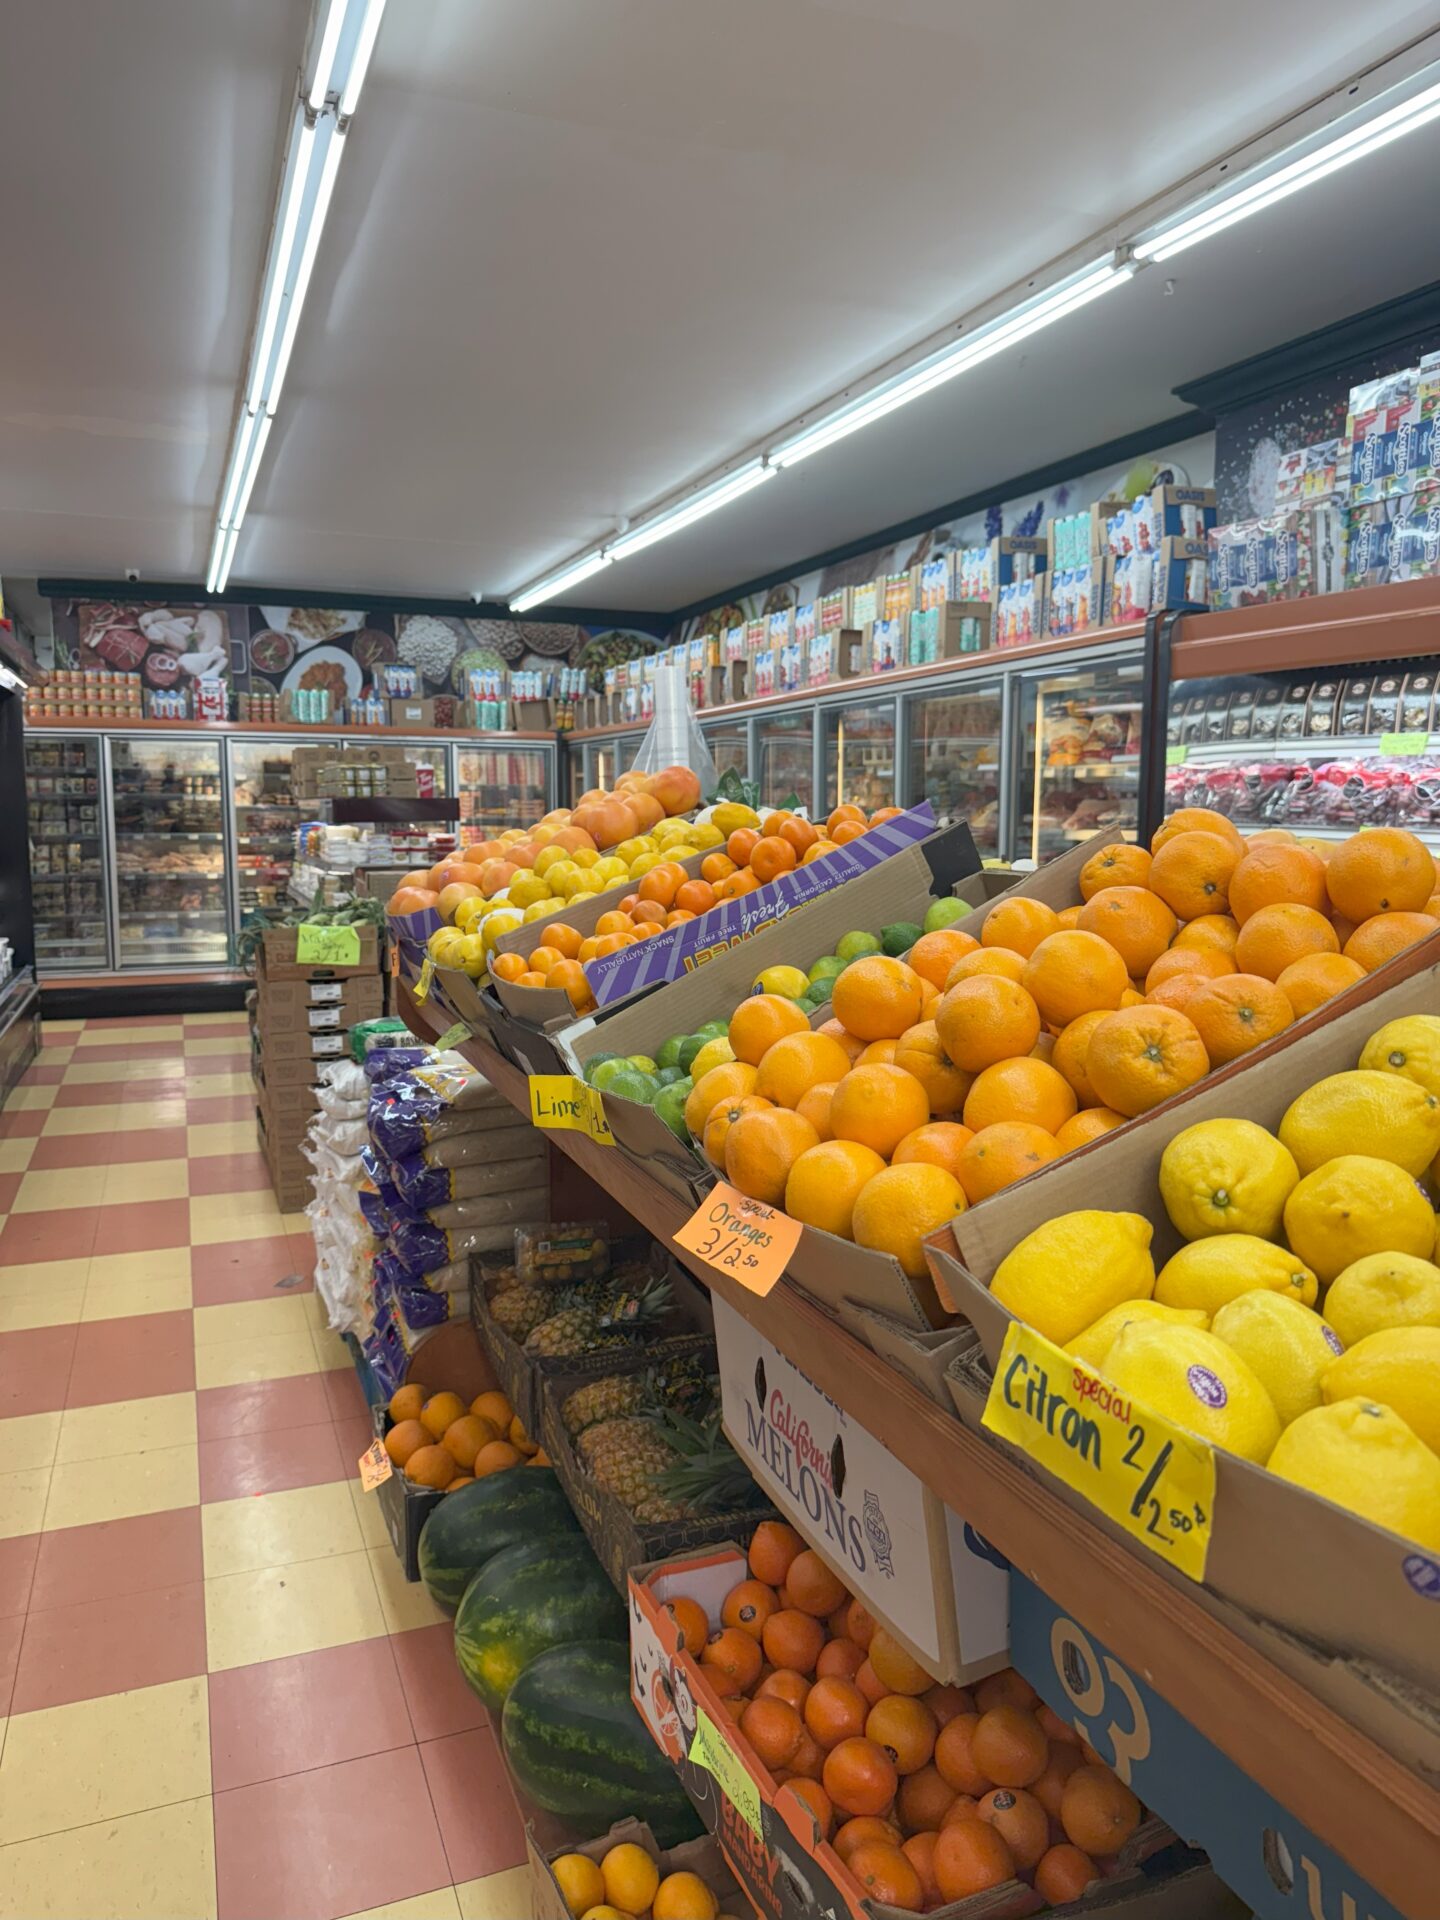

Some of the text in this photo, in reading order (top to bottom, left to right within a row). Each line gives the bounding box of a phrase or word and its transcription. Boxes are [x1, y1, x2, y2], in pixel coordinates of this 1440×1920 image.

[1362, 432, 1376, 485] Scotties
[1396, 422, 1411, 477] Scotties
[1358, 522, 1372, 574] Scotties
[693, 863, 860, 949] QUALITY CALIFORNIA Fresh TREE FRUIT
[596, 934, 675, 975] SNACK NATURALLY
[709, 1202, 773, 1248] Oranges
[1004, 1353, 1101, 1472] Citron
[1072, 1367, 1132, 1425] Special
[744, 1398, 866, 1573] MELONS
